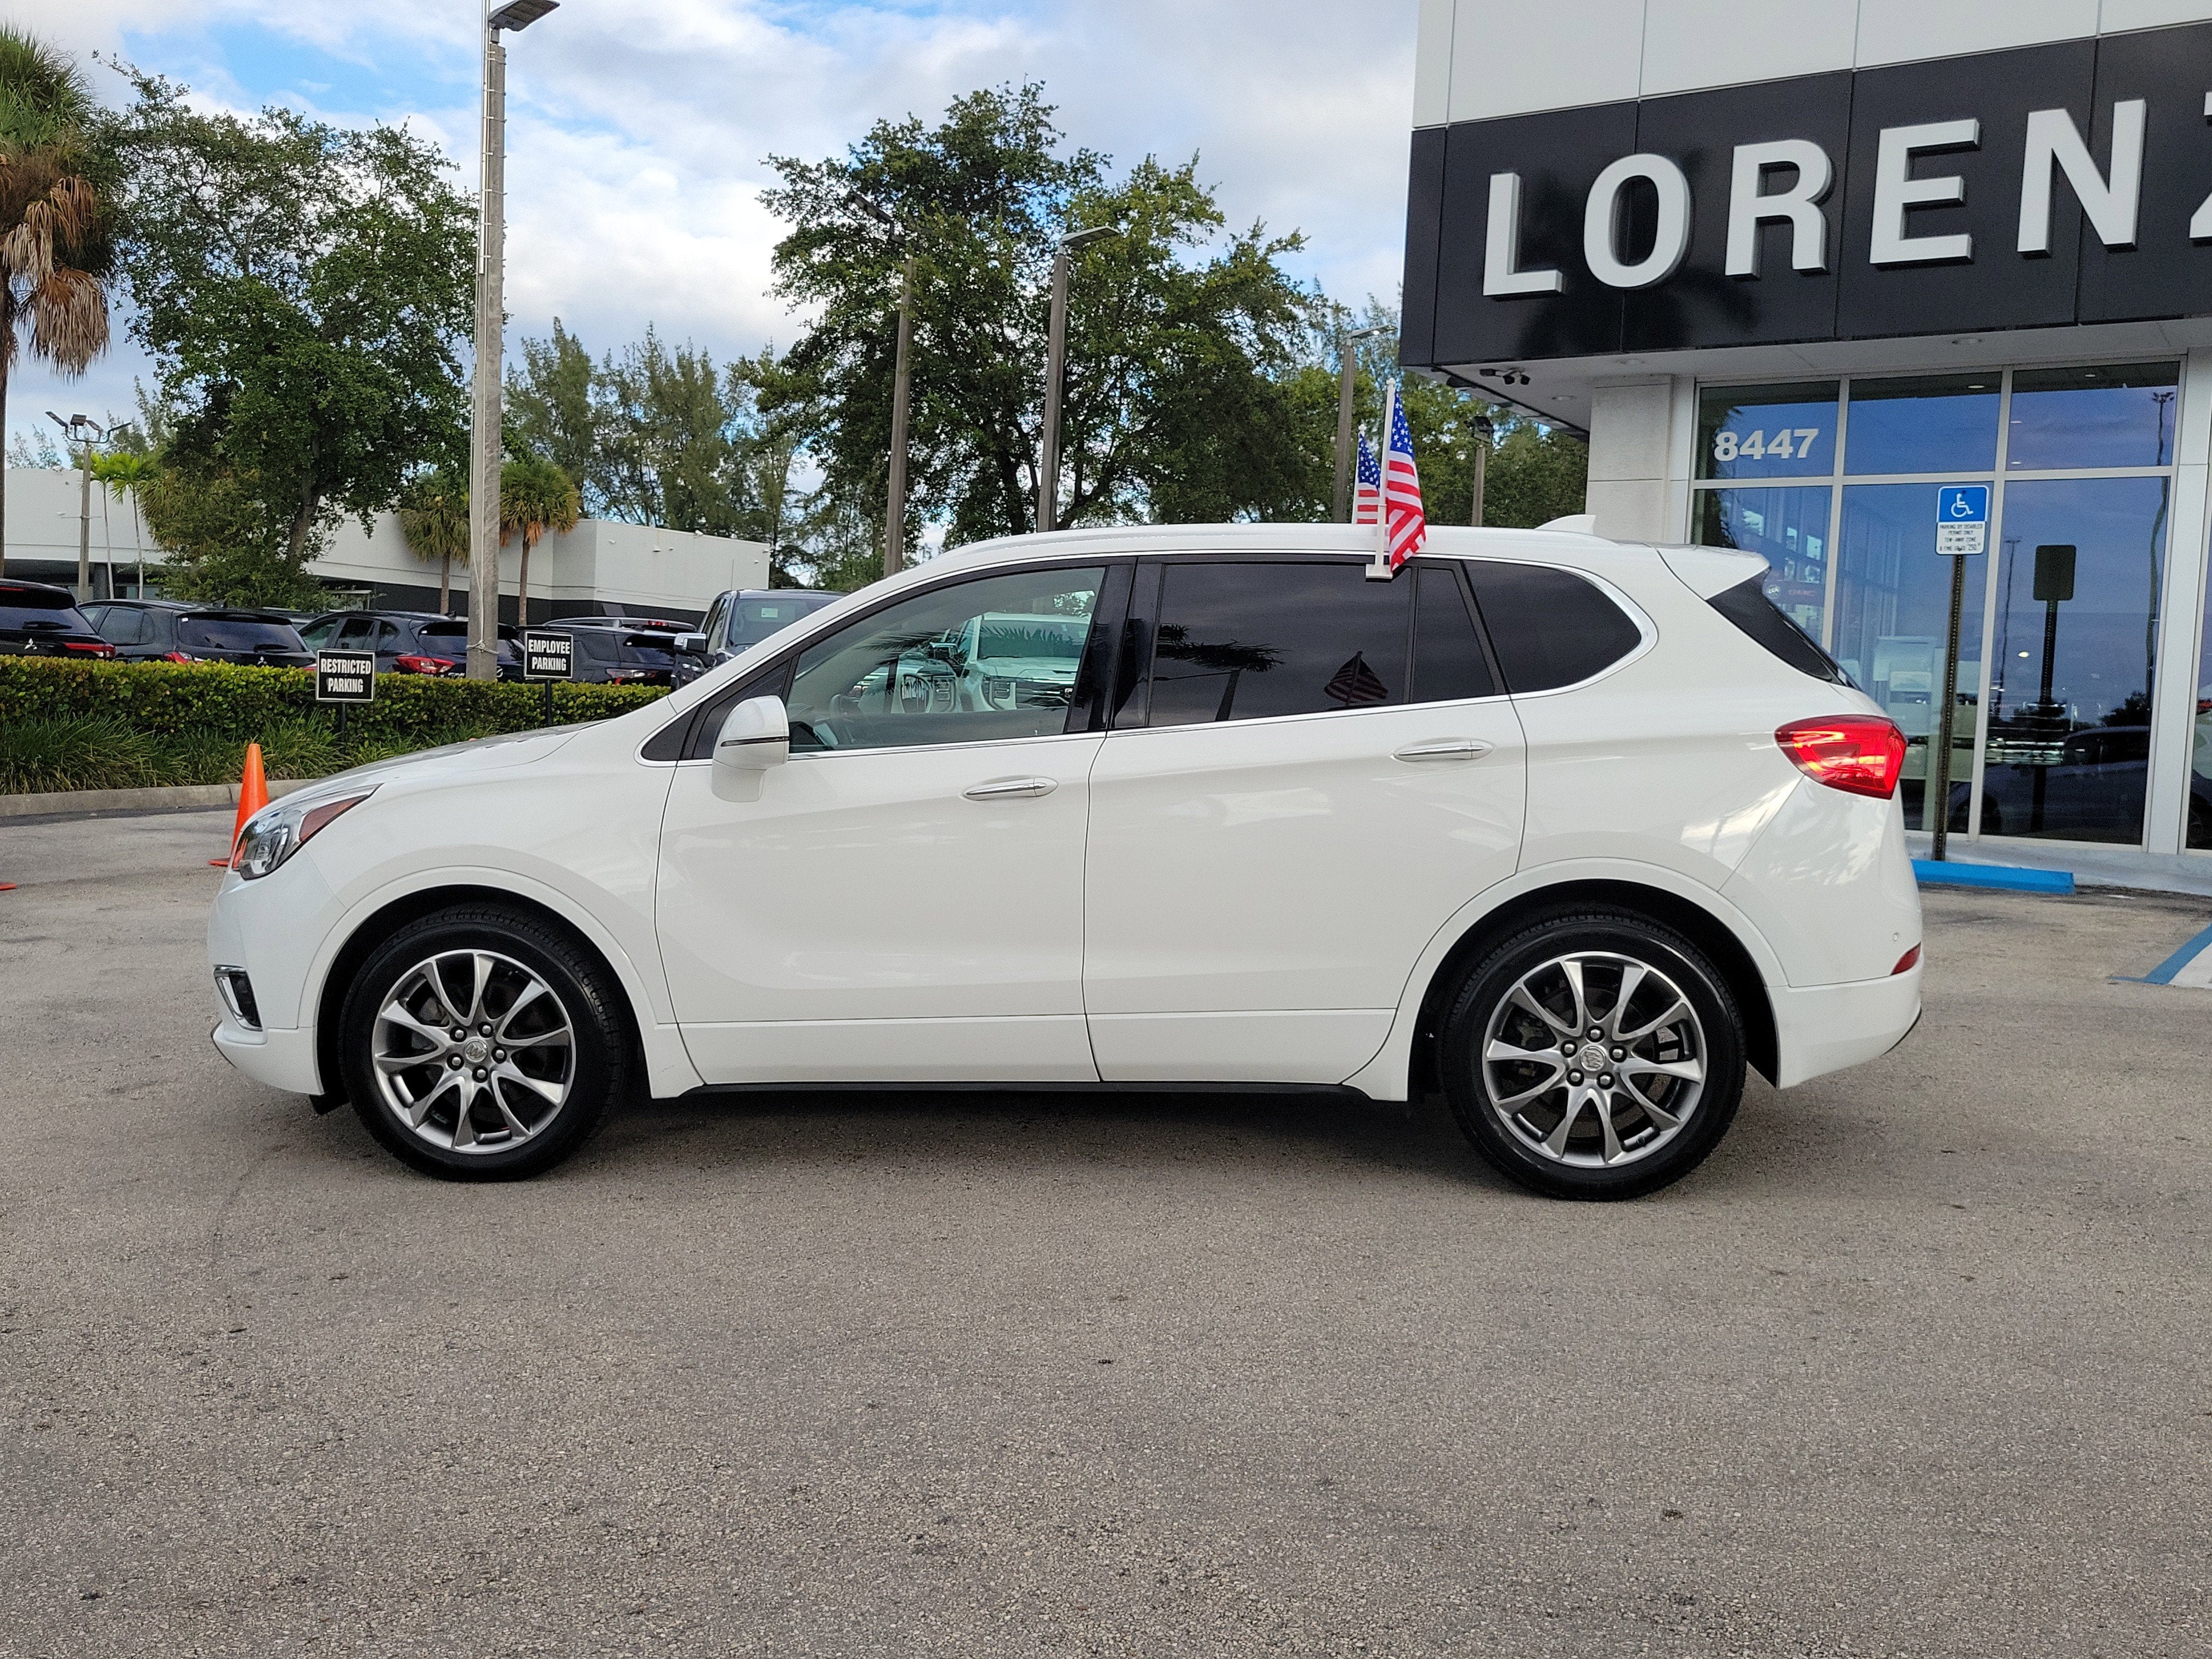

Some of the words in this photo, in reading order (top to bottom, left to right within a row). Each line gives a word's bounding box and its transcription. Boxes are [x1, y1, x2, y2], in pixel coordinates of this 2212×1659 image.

[1483, 91, 2212, 296] LOREN
[1714, 428, 1819, 461] 8447
[528, 639, 571, 654] EMPLOYEE
[320, 658, 371, 674] RESTRICTED
[532, 656, 567, 671] PARKING
[328, 678, 364, 693] PARKING
